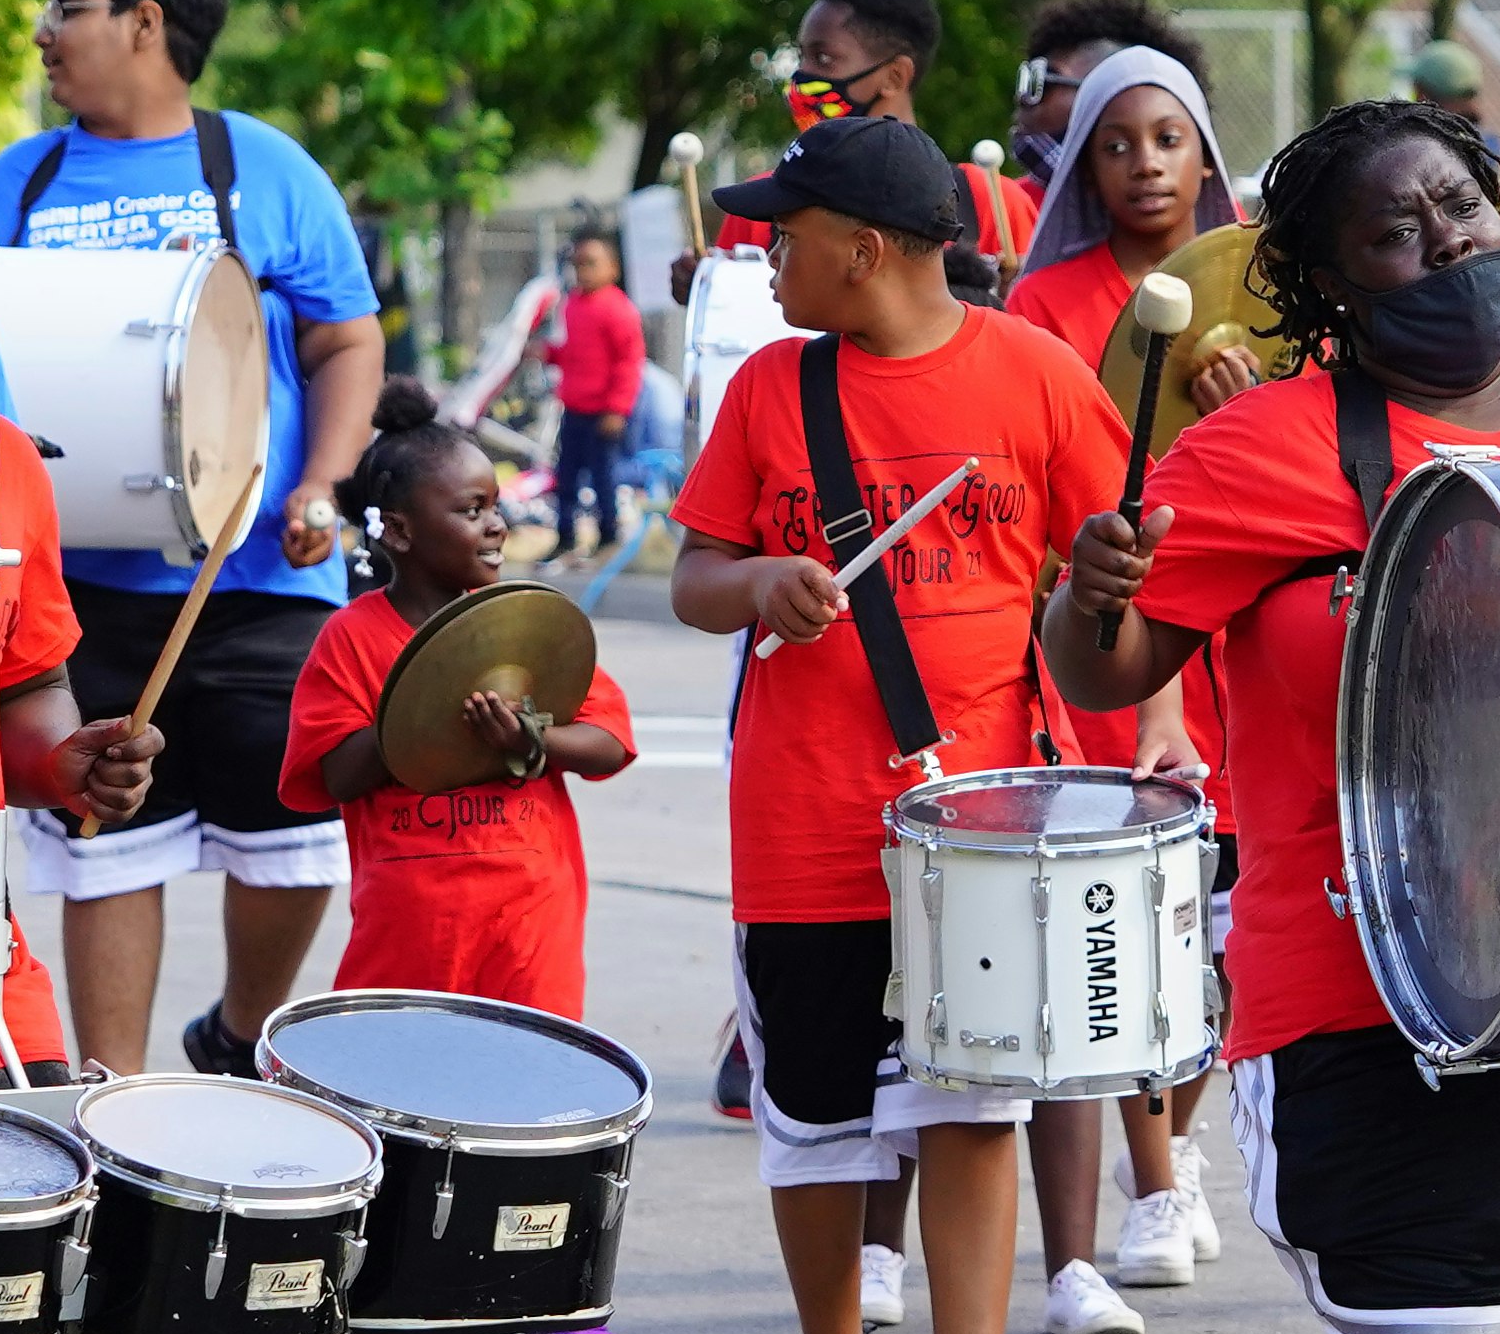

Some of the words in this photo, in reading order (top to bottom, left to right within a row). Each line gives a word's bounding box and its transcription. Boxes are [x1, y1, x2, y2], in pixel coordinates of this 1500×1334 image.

[113, 193, 187, 216] Greater
[28, 214, 150, 244] GREATER
[945, 471, 1027, 540] GOOD
[966, 550, 982, 576] 21
[390, 805, 411, 832] 20
[417, 789, 508, 841] TOUR
[518, 799, 535, 823] 21
[1086, 919, 1119, 1043] YAMAHA
[506, 1211, 558, 1236] Pearl
[259, 1269, 313, 1293] Pearl
